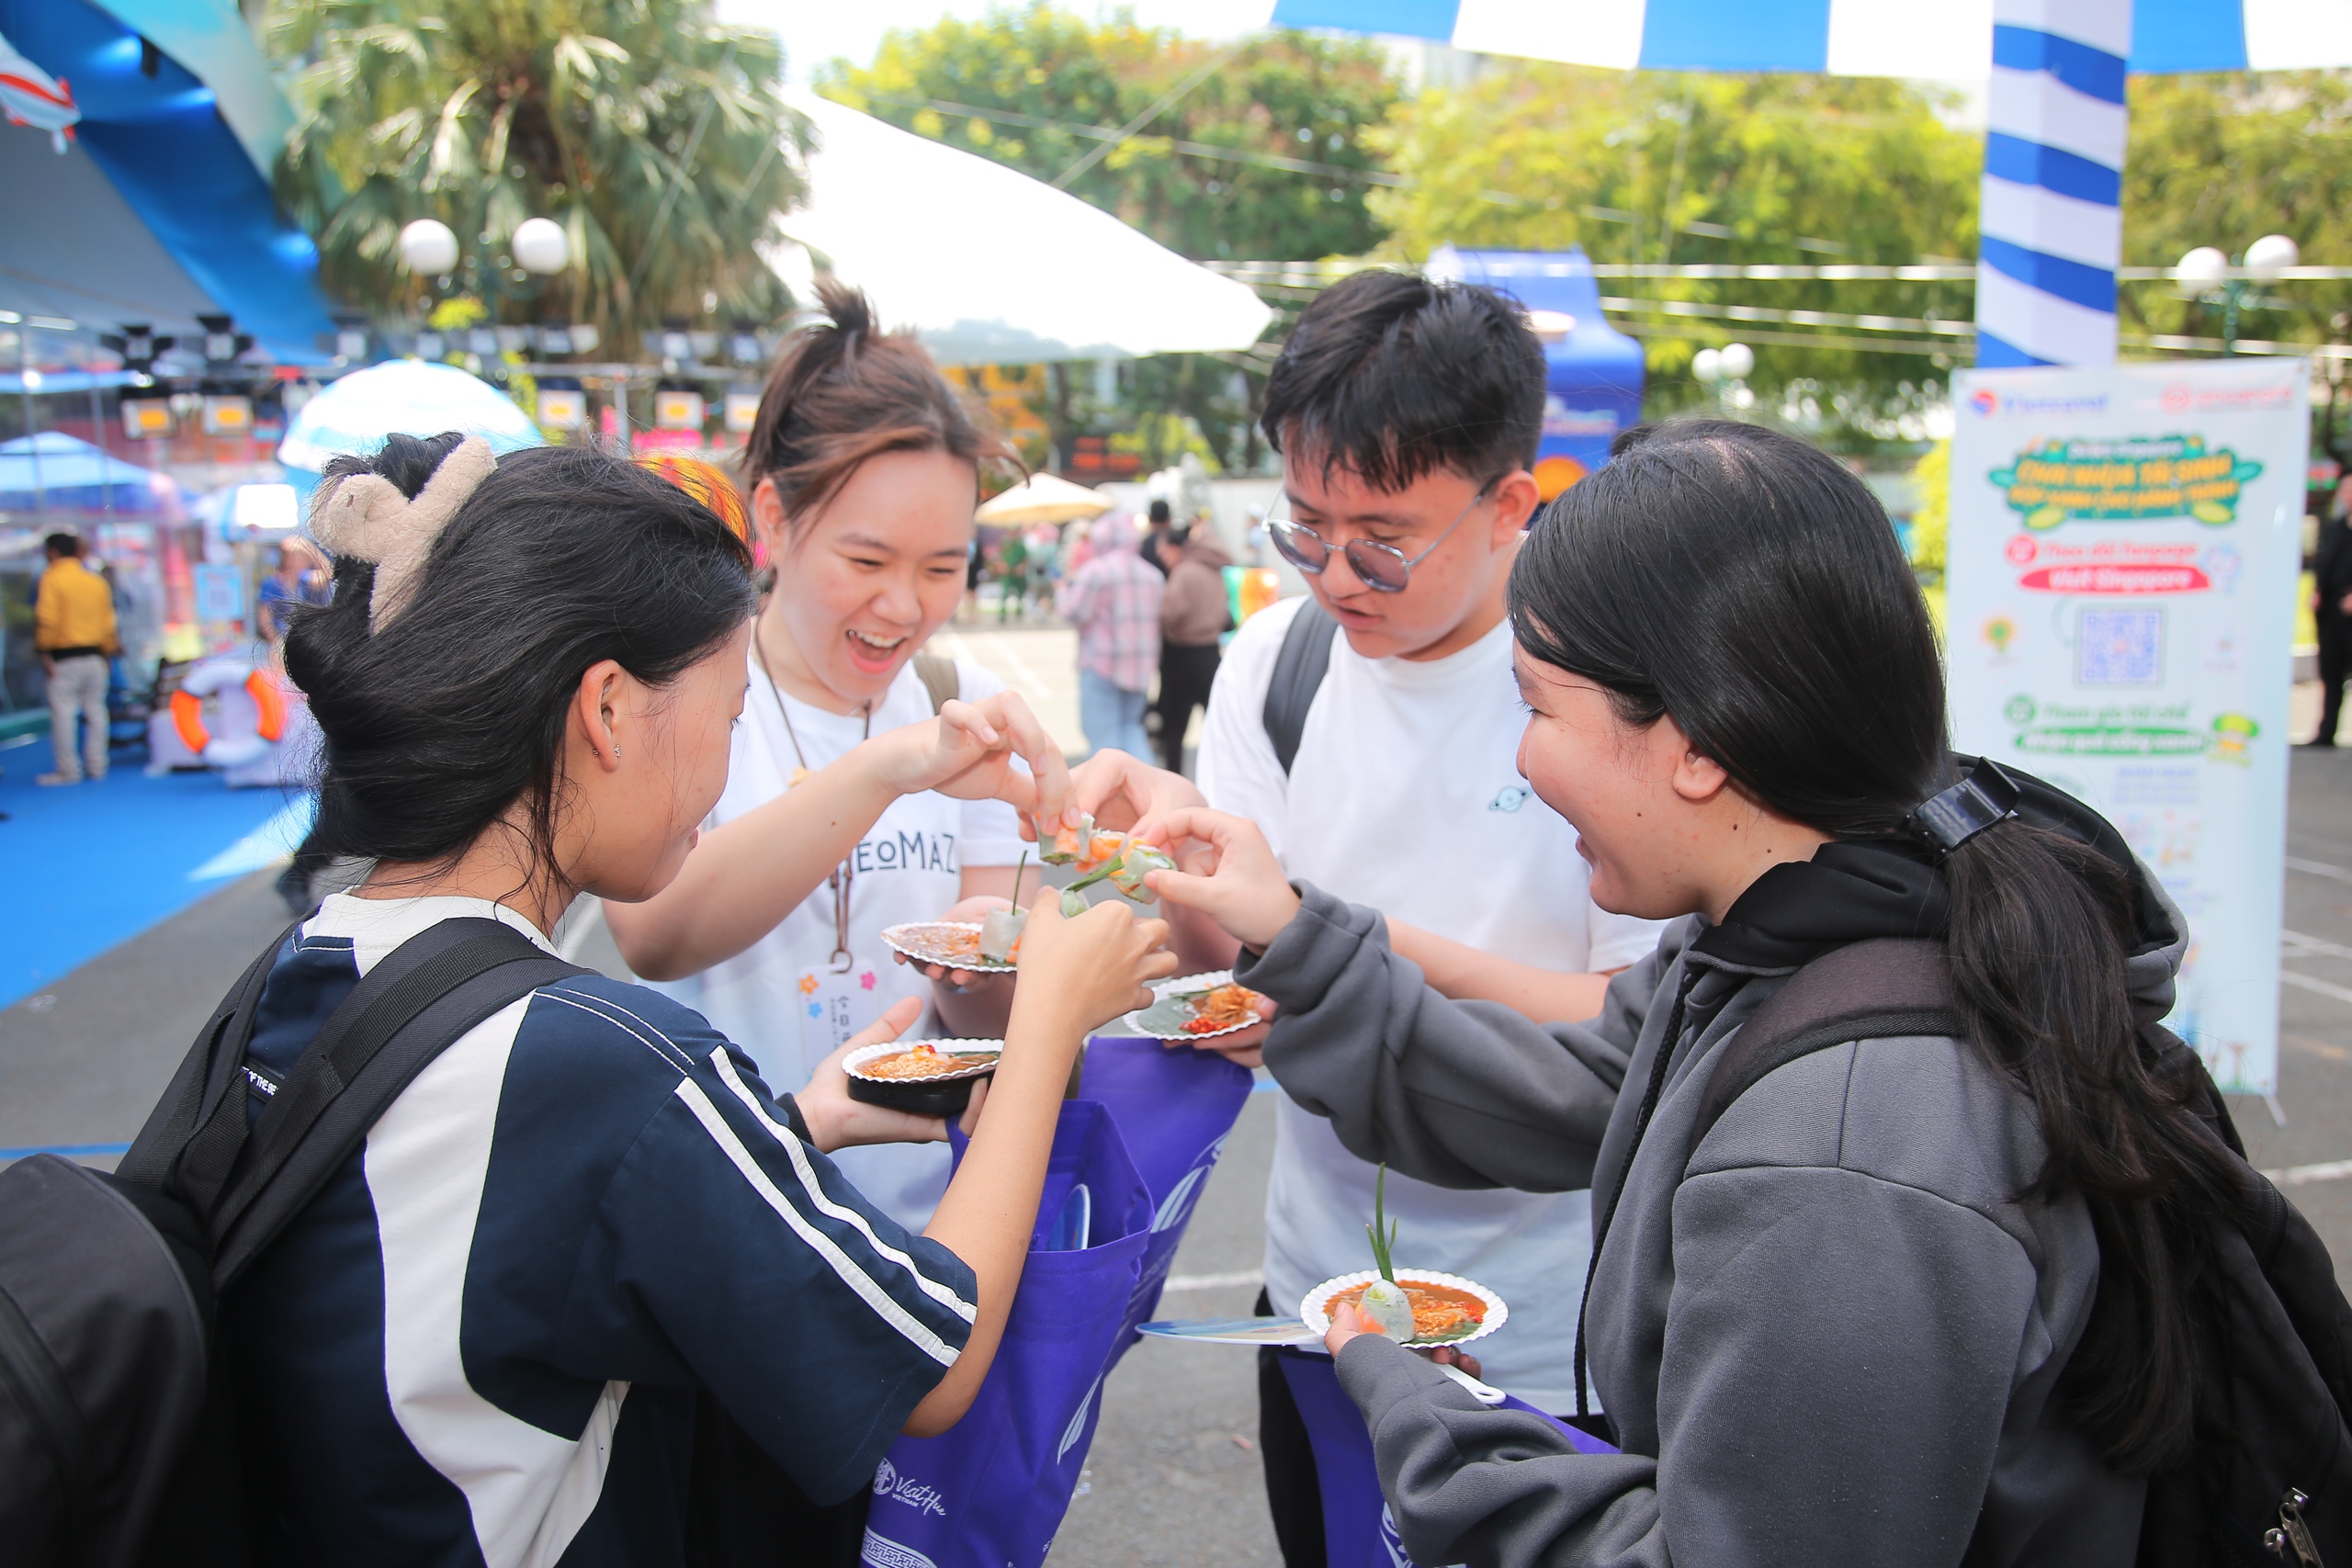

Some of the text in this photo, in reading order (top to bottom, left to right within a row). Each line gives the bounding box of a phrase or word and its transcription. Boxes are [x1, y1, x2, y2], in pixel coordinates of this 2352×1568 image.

[891, 1492, 920, 1508] VIETNAM
[896, 1476, 946, 1517] Visit Hue
